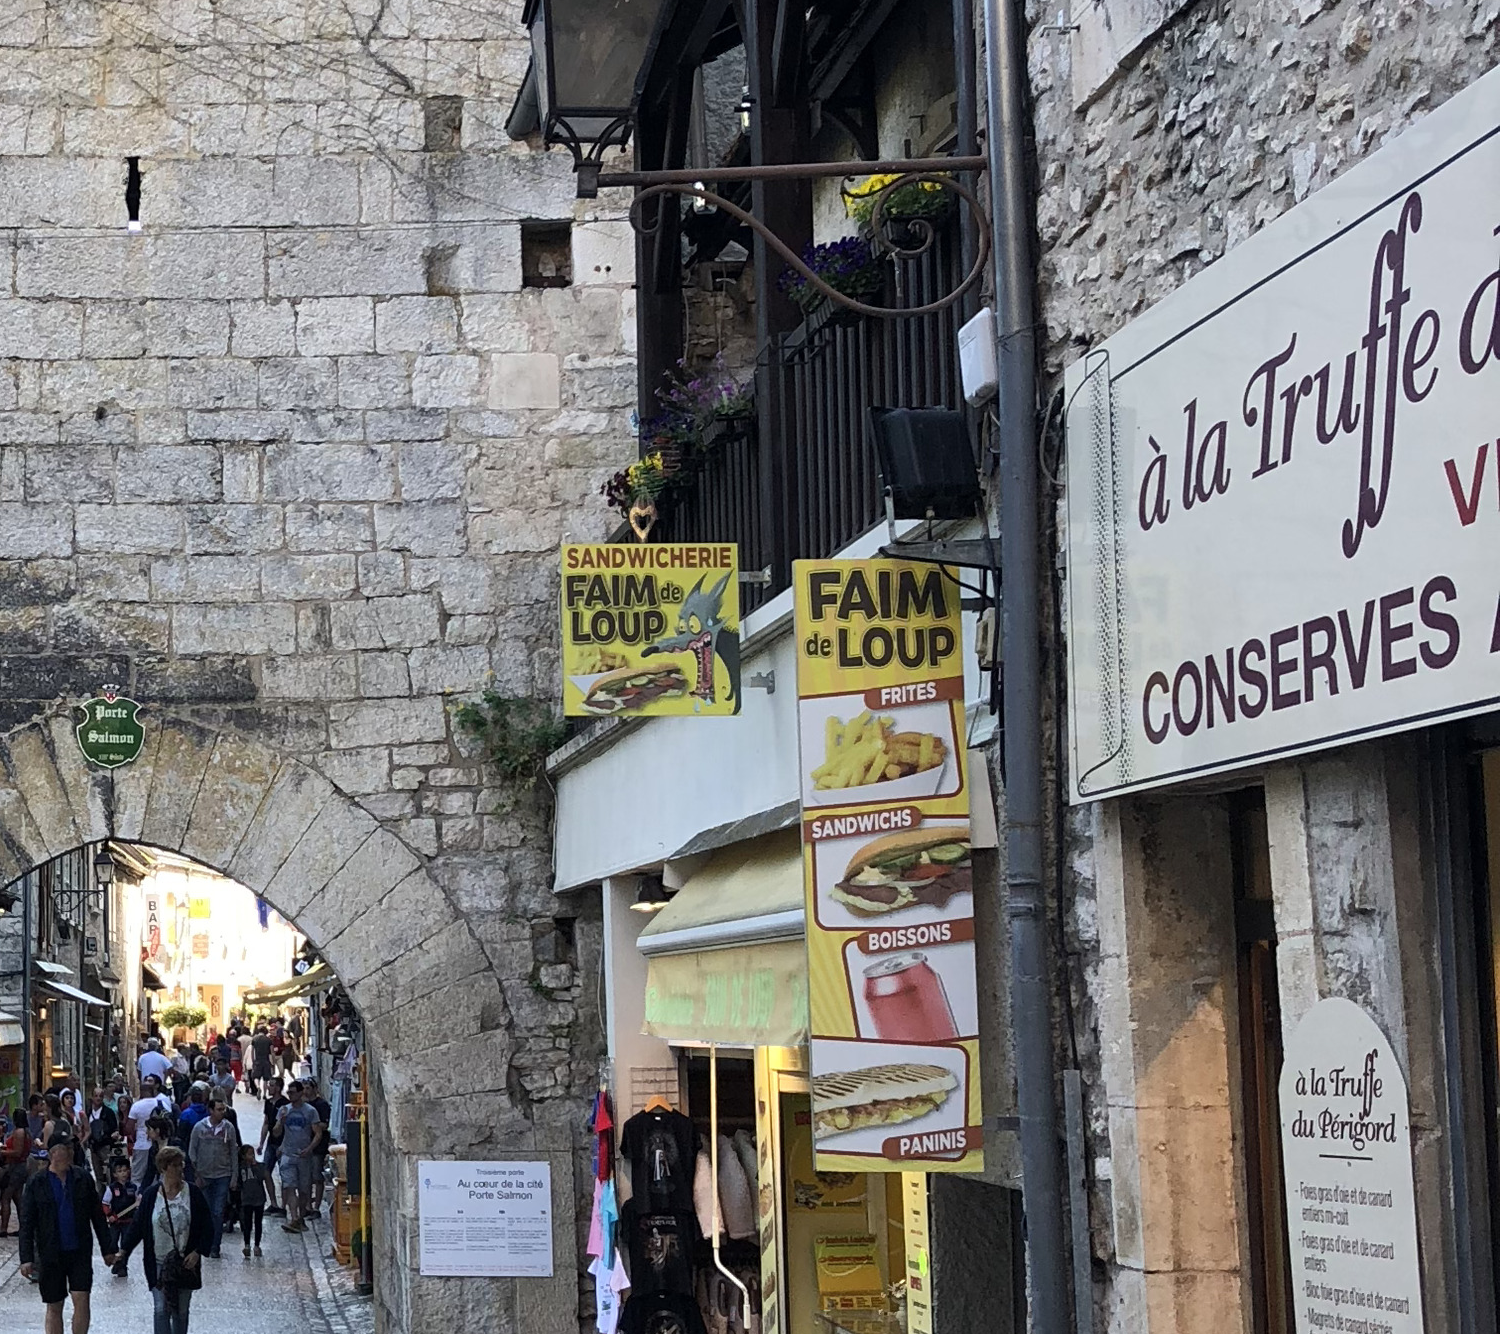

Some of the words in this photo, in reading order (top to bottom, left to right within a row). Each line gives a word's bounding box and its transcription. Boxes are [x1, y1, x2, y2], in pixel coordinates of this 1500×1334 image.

[1138, 435, 1171, 531] à
[1182, 397, 1231, 510] la
[1242, 192, 1441, 559] Truffe
[1459, 227, 1500, 374] d
[566, 547, 732, 569] SANDWICHERIE
[565, 575, 657, 608] FAIM
[660, 582, 683, 602] de
[809, 570, 948, 620] FAIM
[572, 611, 665, 644] LOUP
[805, 632, 832, 657] de
[837, 627, 955, 668] LOUP
[1142, 575, 1461, 745] CONSERVES
[881, 681, 937, 706] FRITES
[95, 705, 128, 721] Porte
[88, 730, 134, 744] Salmon
[811, 809, 912, 840] SANDWICHS
[867, 923, 952, 952] BOISSONS
[1295, 1069, 1307, 1096] à
[1310, 1068, 1327, 1097] la
[1329, 1048, 1383, 1121] Truffe
[899, 1130, 967, 1156] PANINIS
[1292, 1110, 1315, 1138] du
[1318, 1107, 1397, 1151] Périgord
[457, 1179, 471, 1188] Au
[501, 1179, 513, 1188] de
[516, 1179, 524, 1188] la
[527, 1179, 544, 1188] cité
[469, 1191, 494, 1200] Porte
[497, 1190, 532, 1200] Salmon
[1318, 1186, 1332, 1204] gras
[1350, 1187, 1358, 1203] et
[1358, 1187, 1367, 1206] de
[1368, 1190, 1393, 1208] canard
[1319, 1235, 1334, 1254] gras
[1352, 1238, 1359, 1255] et
[1360, 1238, 1369, 1256] de
[1370, 1242, 1395, 1260] canard
[1334, 1287, 1349, 1306] gras
[1366, 1289, 1374, 1307] et
[1375, 1291, 1384, 1310] de
[1384, 1296, 1410, 1315] canard
[1335, 1313, 1345, 1331] de
